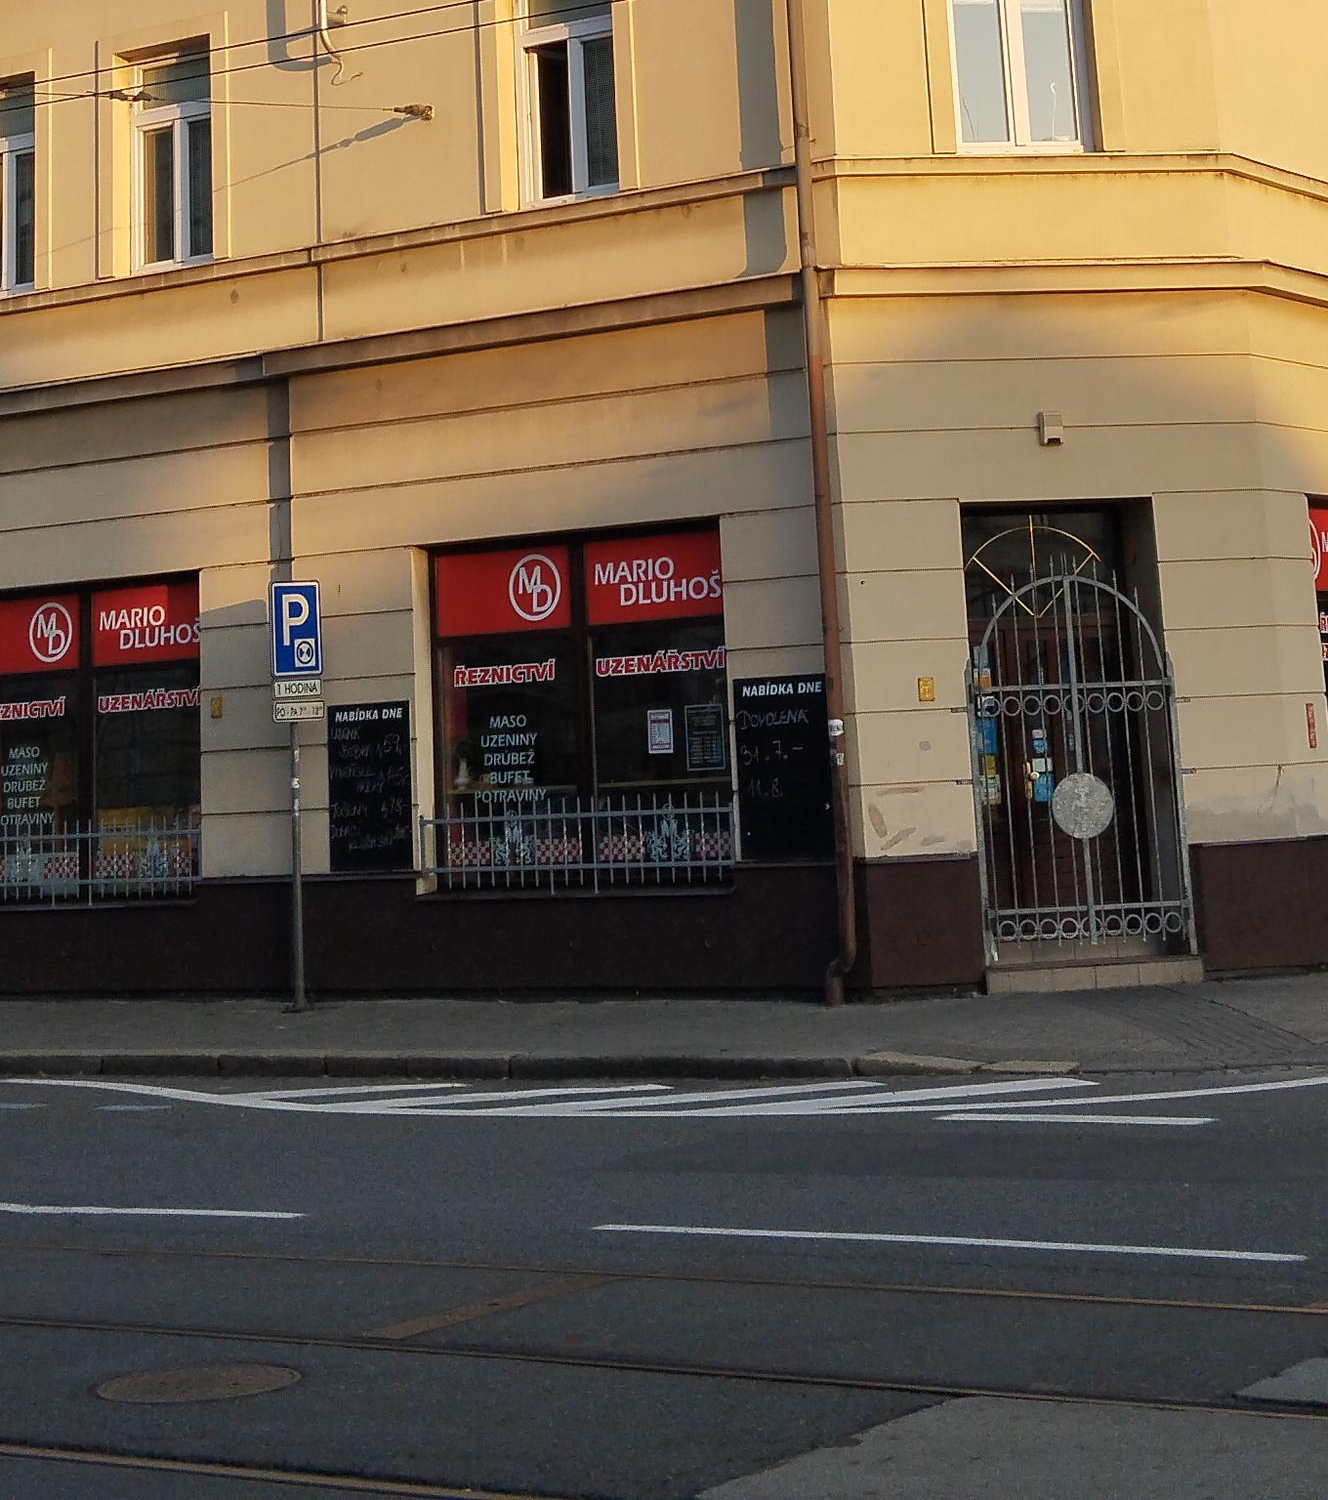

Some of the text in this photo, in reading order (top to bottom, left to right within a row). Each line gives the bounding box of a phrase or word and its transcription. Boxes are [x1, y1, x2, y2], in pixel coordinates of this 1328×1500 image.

[594, 557, 674, 586] MARIO
[518, 565, 552, 613] MD
[620, 569, 722, 606] DLUHOŠ
[99, 605, 165, 631] MARIO
[282, 593, 309, 646] P
[37, 612, 66, 655] MD
[120, 618, 201, 650] DLUHOŠ
[454, 645, 727, 688] ŘEZNICTVÍ UZENÁŘSTVÍ
[277, 684, 281, 695] 1
[742, 681, 822, 697] NABÍDKA DNE
[335, 708, 379, 722] NABÍDKA
[382, 707, 403, 719] DNE
[489, 714, 527, 728] MASO
[735, 709, 809, 730] DOVOLENÁ
[480, 732, 538, 748] UZENINY
[9, 746, 40, 759] MASO
[1, 762, 48, 777] UZENINY
[490, 770, 530, 784] BUFET
[7, 796, 41, 809] BUFET
[474, 788, 547, 803] POTRAVINY
